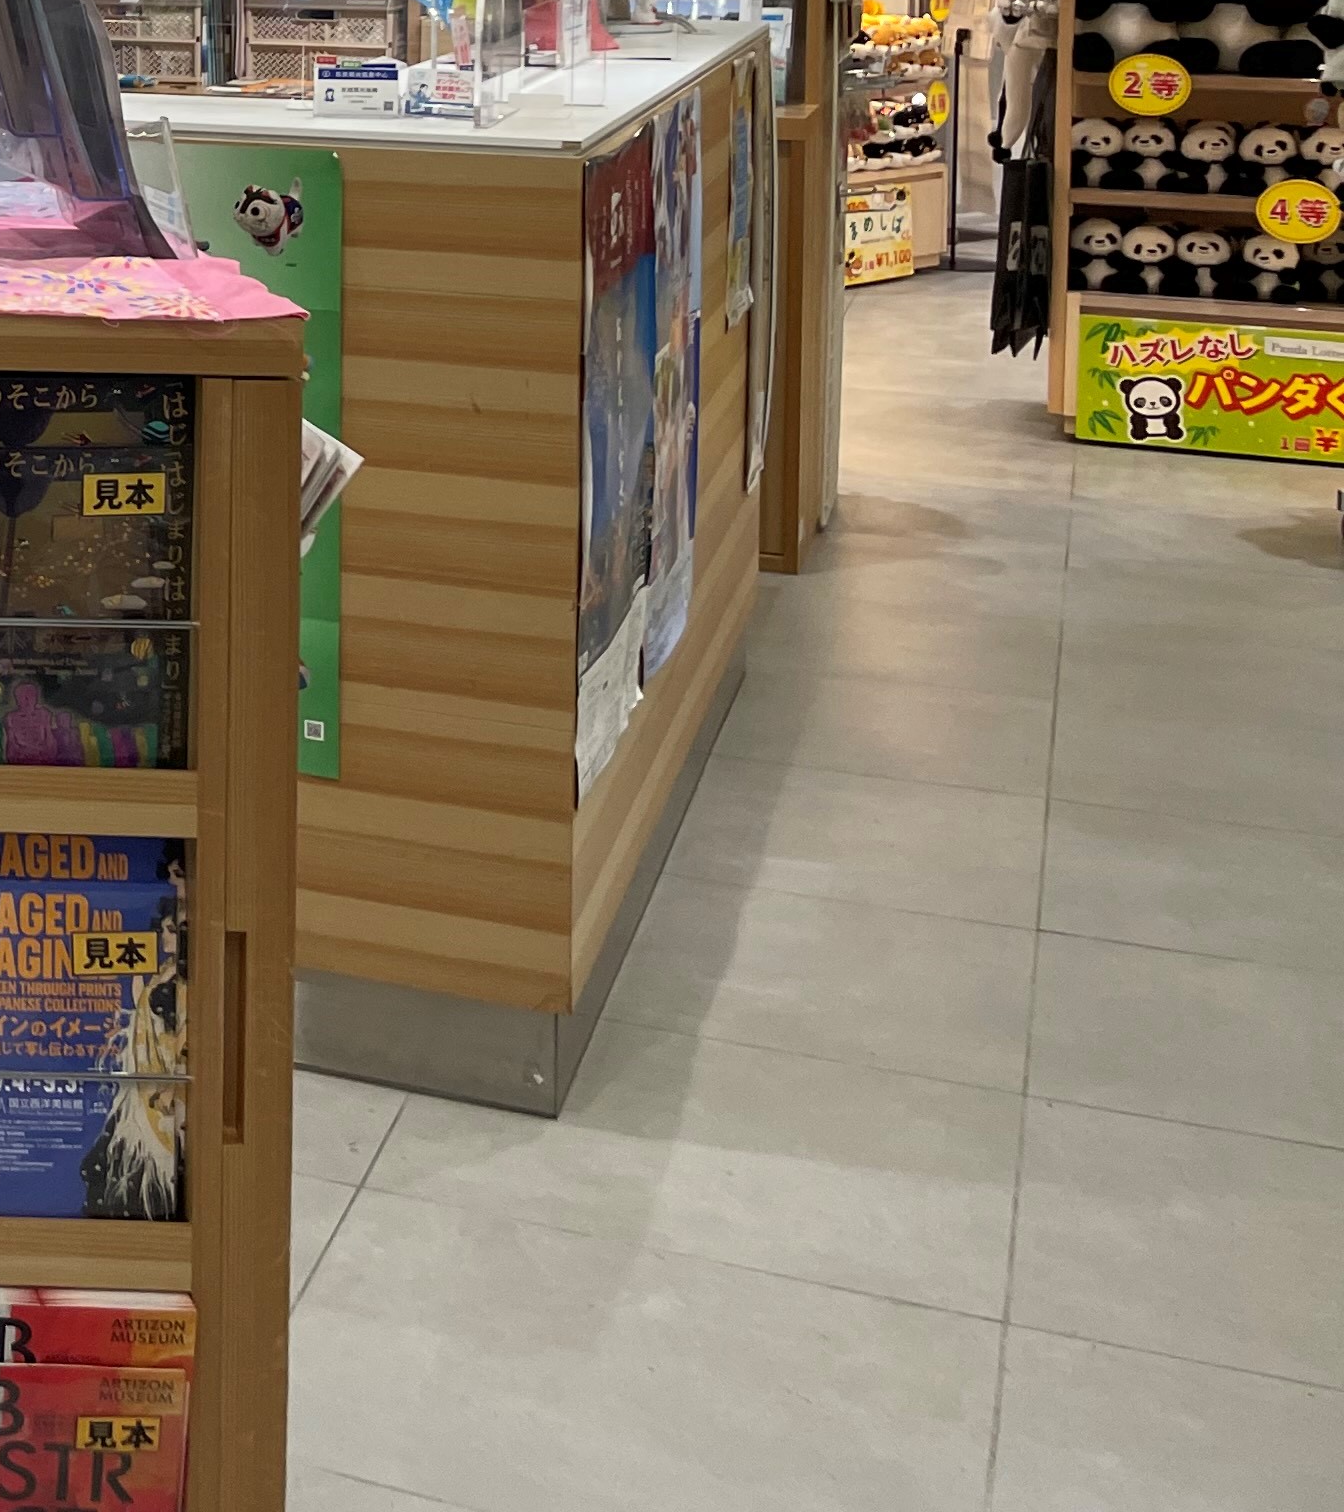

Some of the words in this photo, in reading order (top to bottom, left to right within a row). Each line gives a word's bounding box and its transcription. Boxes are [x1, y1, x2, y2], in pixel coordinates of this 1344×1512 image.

[1123, 71, 1180, 98] 2等
[1269, 198, 1328, 226] 4等
[1109, 333, 1254, 366] ハズレなし
[92, 478, 155, 510] 見本
[97, 853, 129, 881] AND
[92, 909, 123, 932] AND
[83, 937, 147, 970] 見本
[20, 982, 79, 997] THROUGH
[79, 984, 122, 998] PRINTS
[44, 998, 122, 1013] COLLECTIONS
[111, 1317, 186, 1331] ARTIZON
[111, 1331, 186, 1345] MUSEUM
[98, 1376, 174, 1390] ARTIZON
[98, 1391, 174, 1405] MUSEUM
[84, 1419, 156, 1449] 見本
